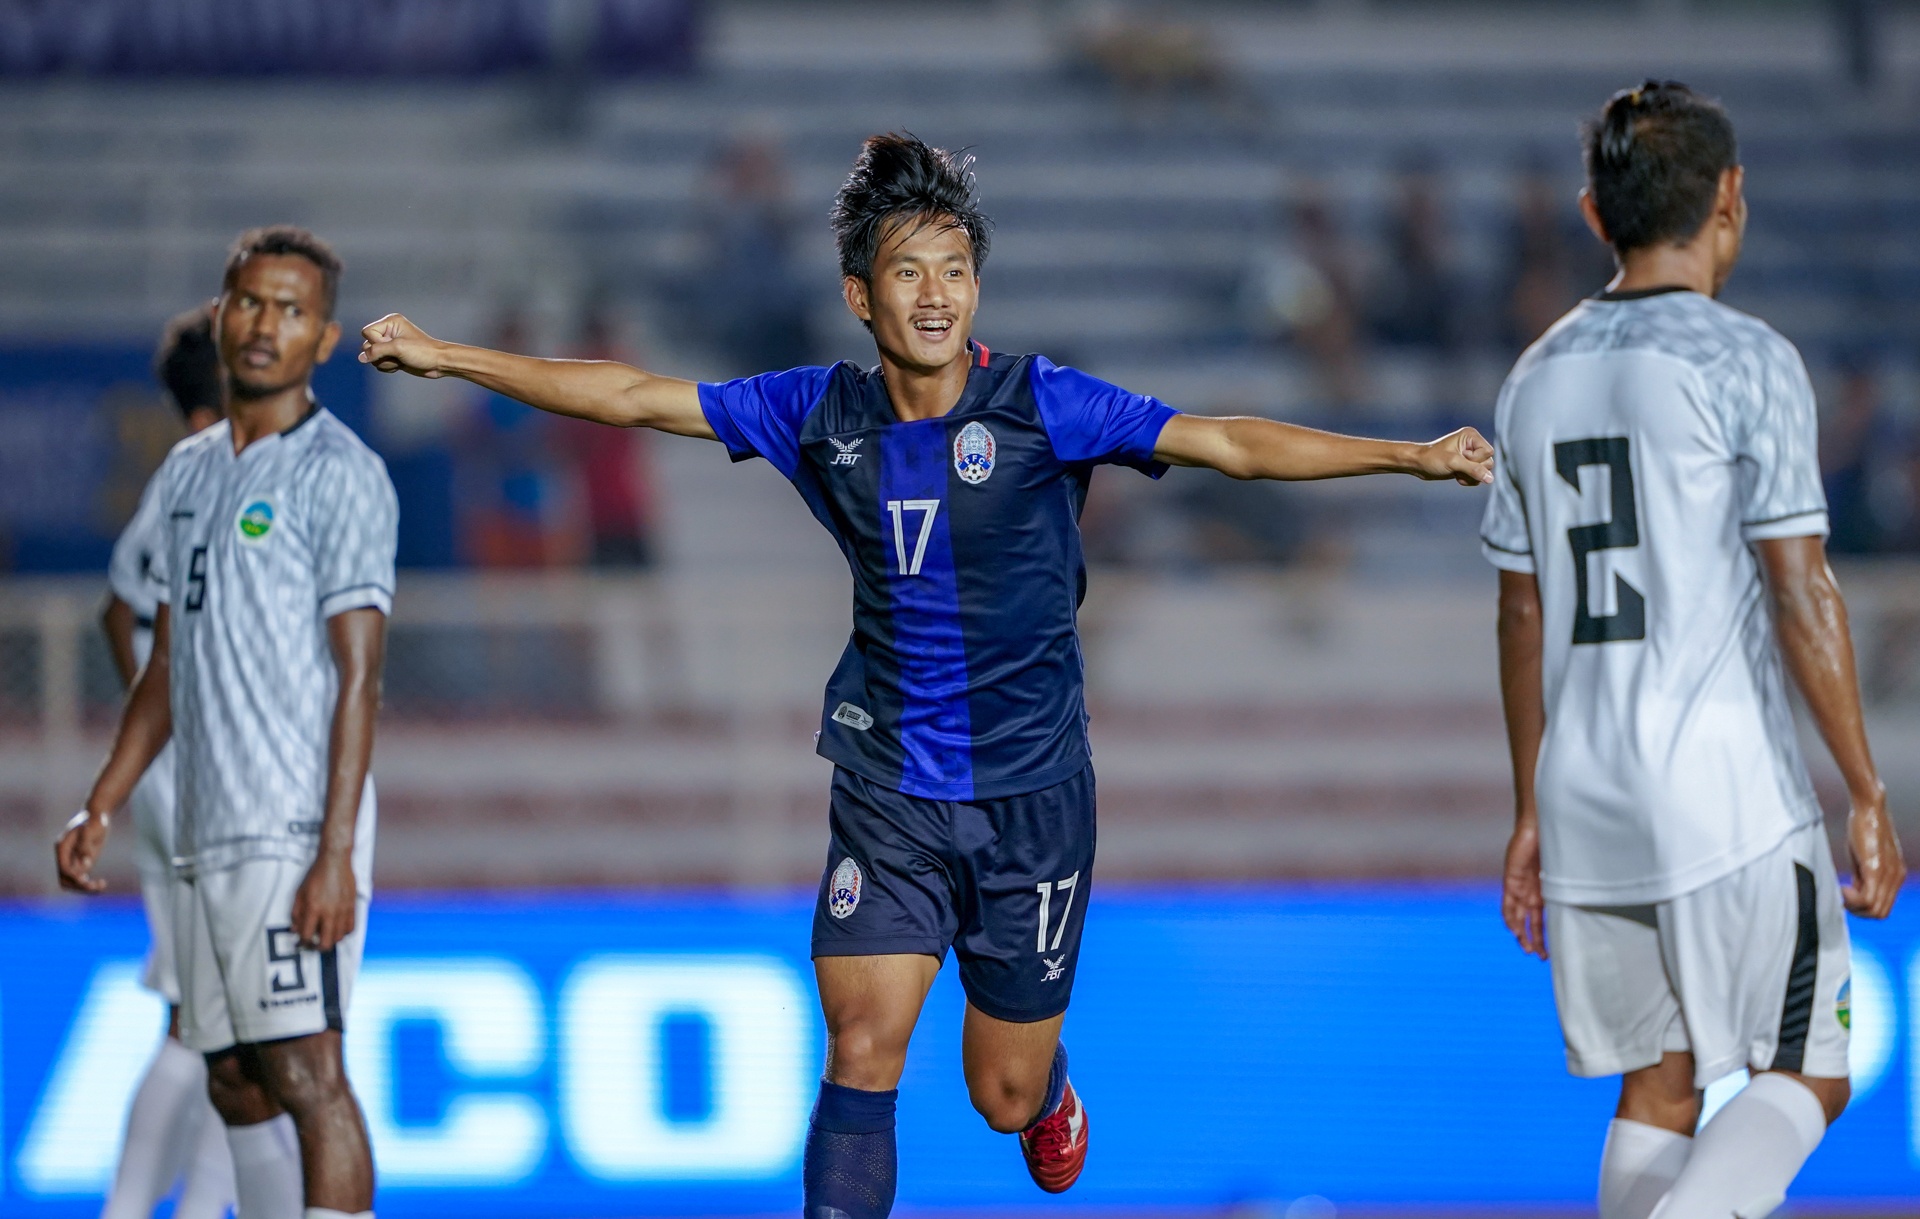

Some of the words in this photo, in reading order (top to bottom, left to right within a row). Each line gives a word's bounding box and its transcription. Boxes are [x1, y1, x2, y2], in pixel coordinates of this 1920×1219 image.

[830, 453, 862, 466] FBT
[964, 454, 986, 465] FFC
[887, 499, 941, 575] 17
[1553, 436, 1646, 645] 2
[1036, 869, 1080, 953] 17
[265, 925, 306, 993] 5
[1040, 967, 1065, 982] FBT
